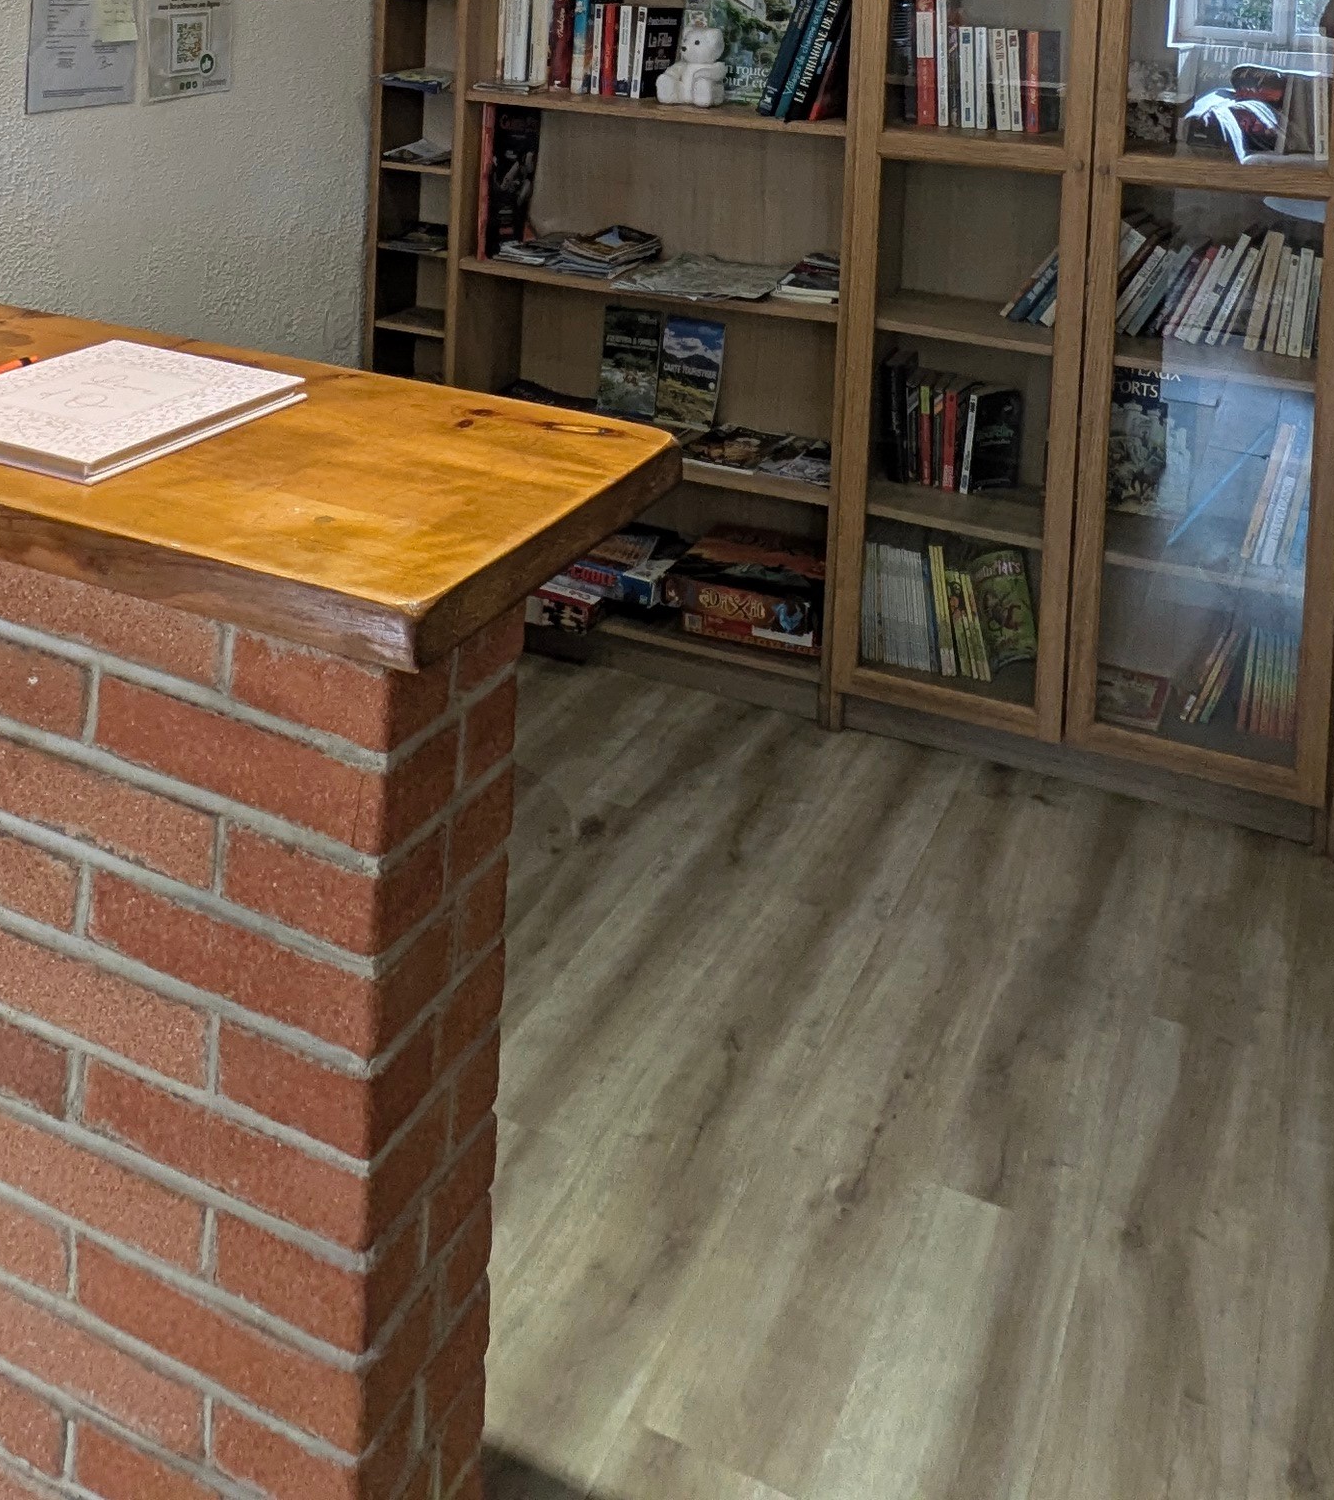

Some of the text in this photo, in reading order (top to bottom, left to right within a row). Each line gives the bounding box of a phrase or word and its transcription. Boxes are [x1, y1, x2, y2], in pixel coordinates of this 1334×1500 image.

[821, 14, 834, 31] DE
[799, 29, 829, 88] PATRIMOINE
[793, 88, 807, 104] LE
